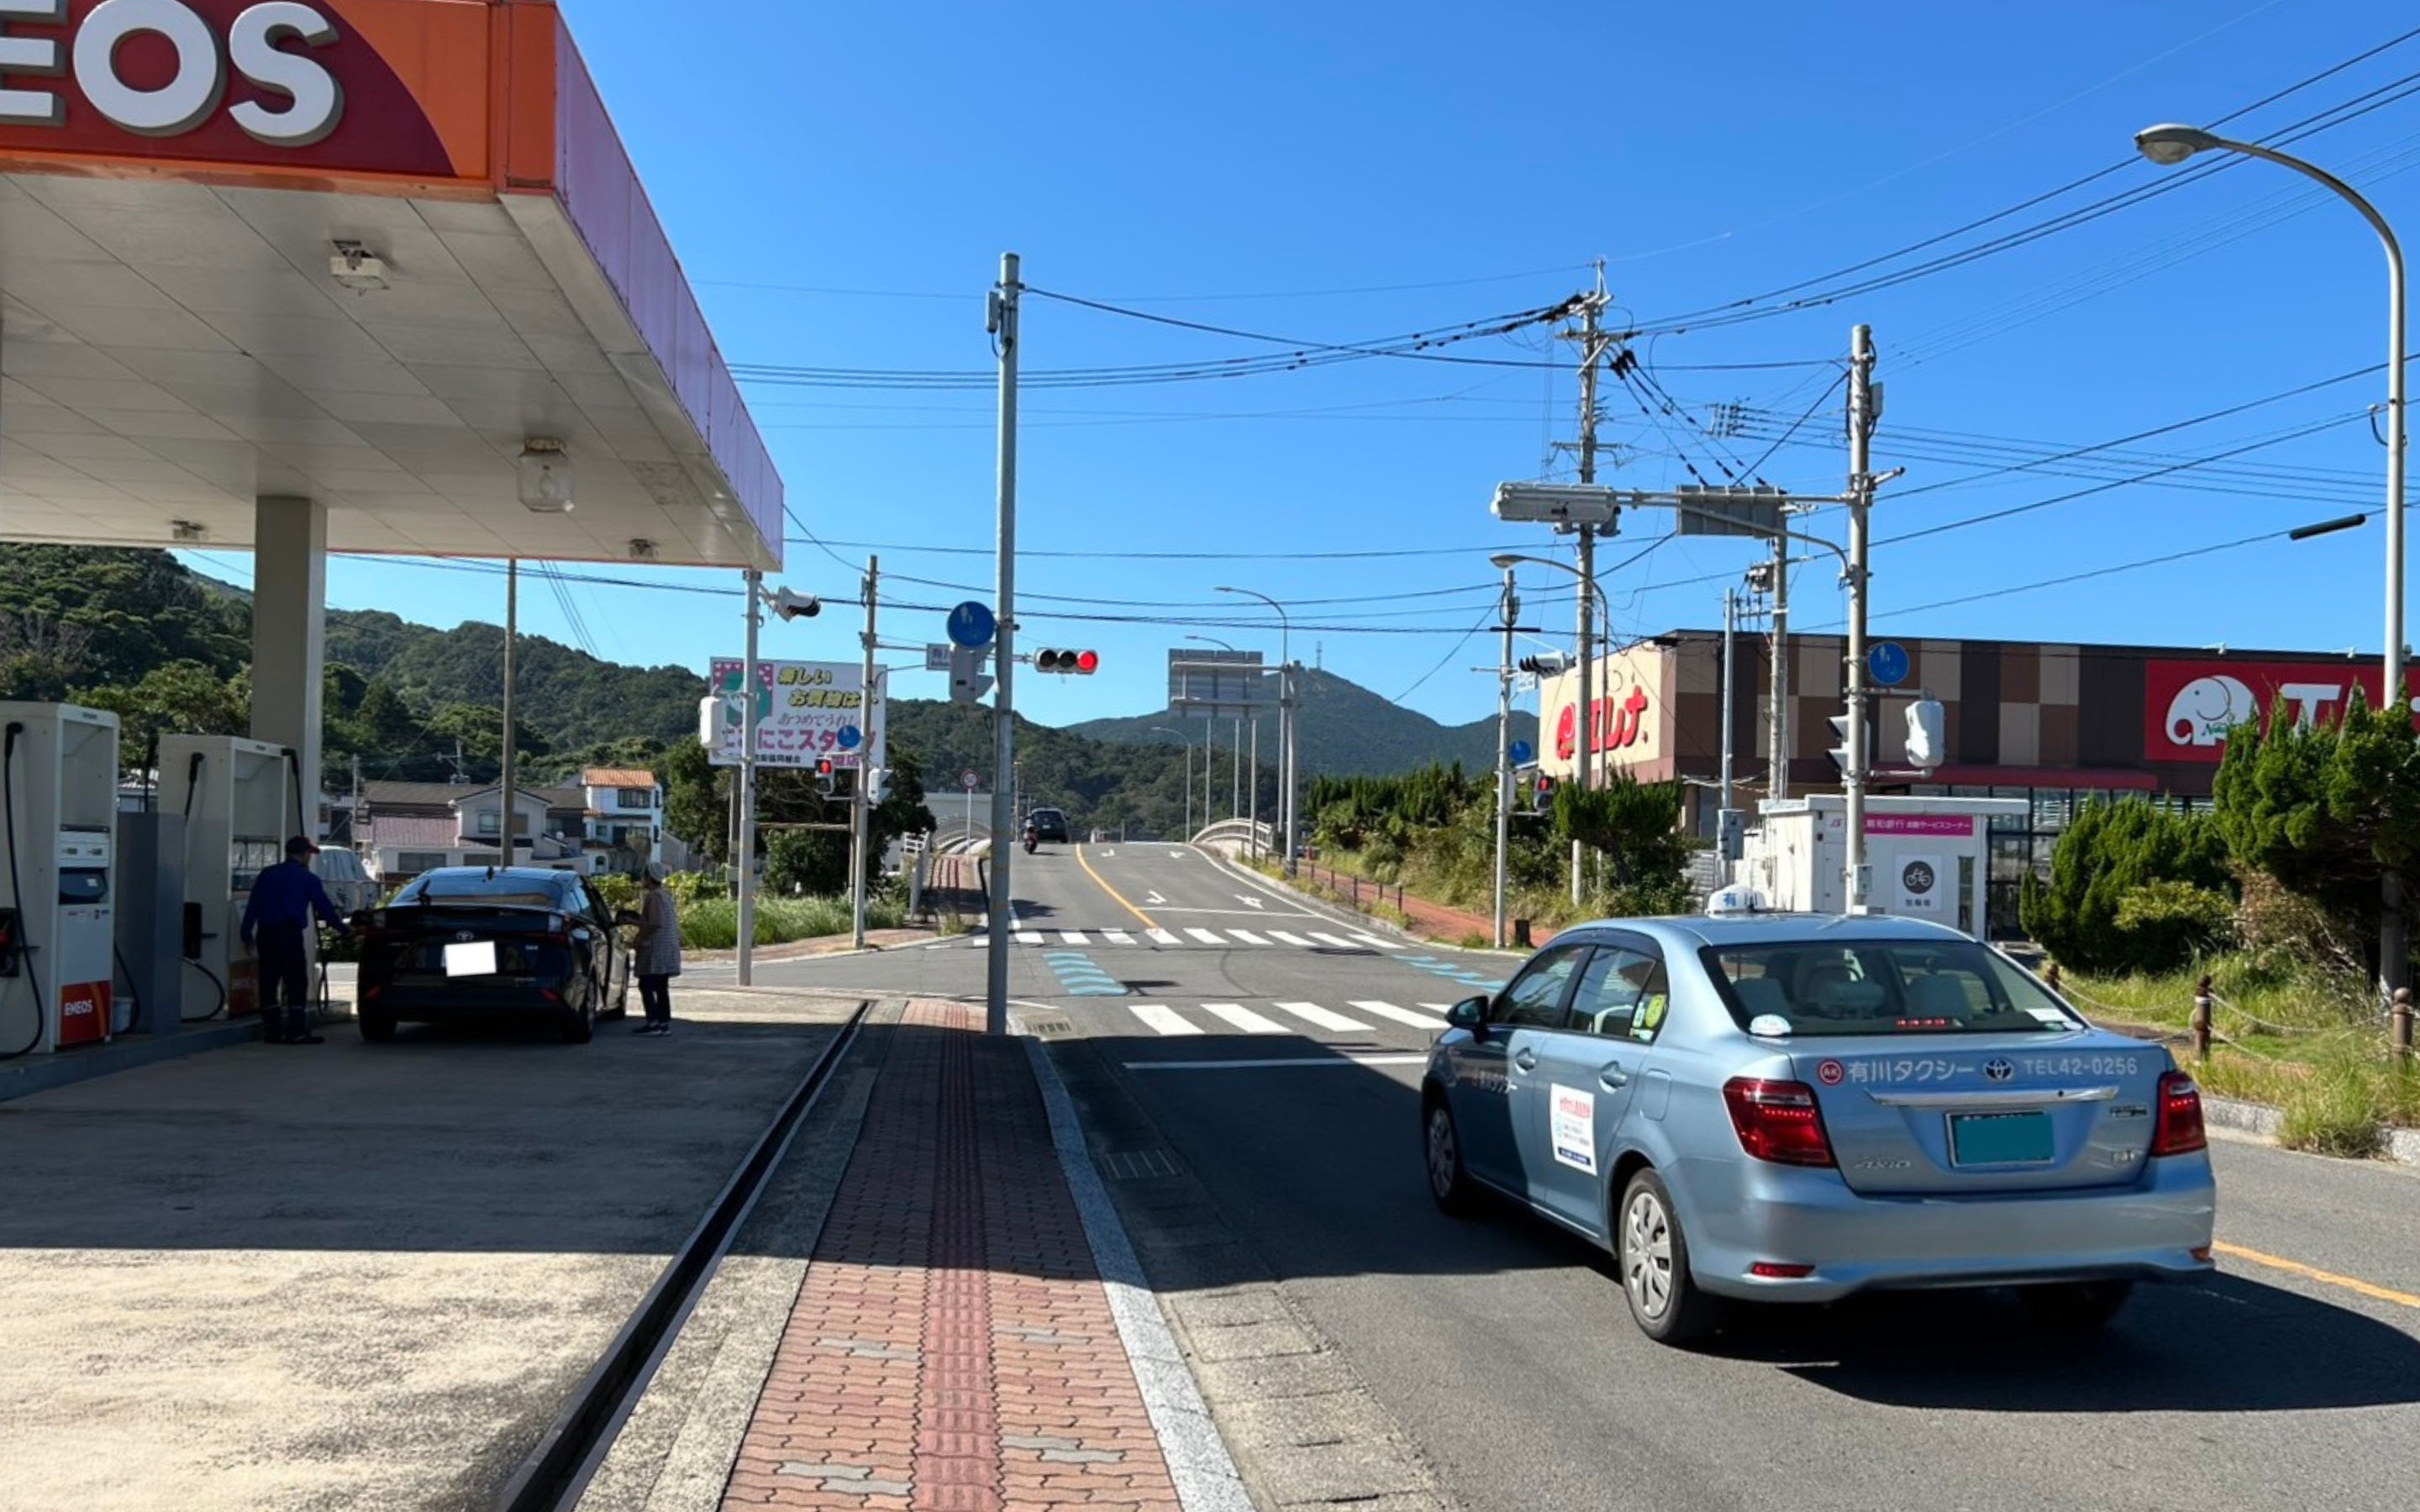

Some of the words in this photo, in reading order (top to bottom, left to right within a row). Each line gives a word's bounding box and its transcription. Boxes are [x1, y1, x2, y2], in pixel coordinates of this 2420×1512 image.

[1849, 1060, 1974, 1083] 有川タクシー
[2023, 1058, 2138, 1077] TEL42-0256
